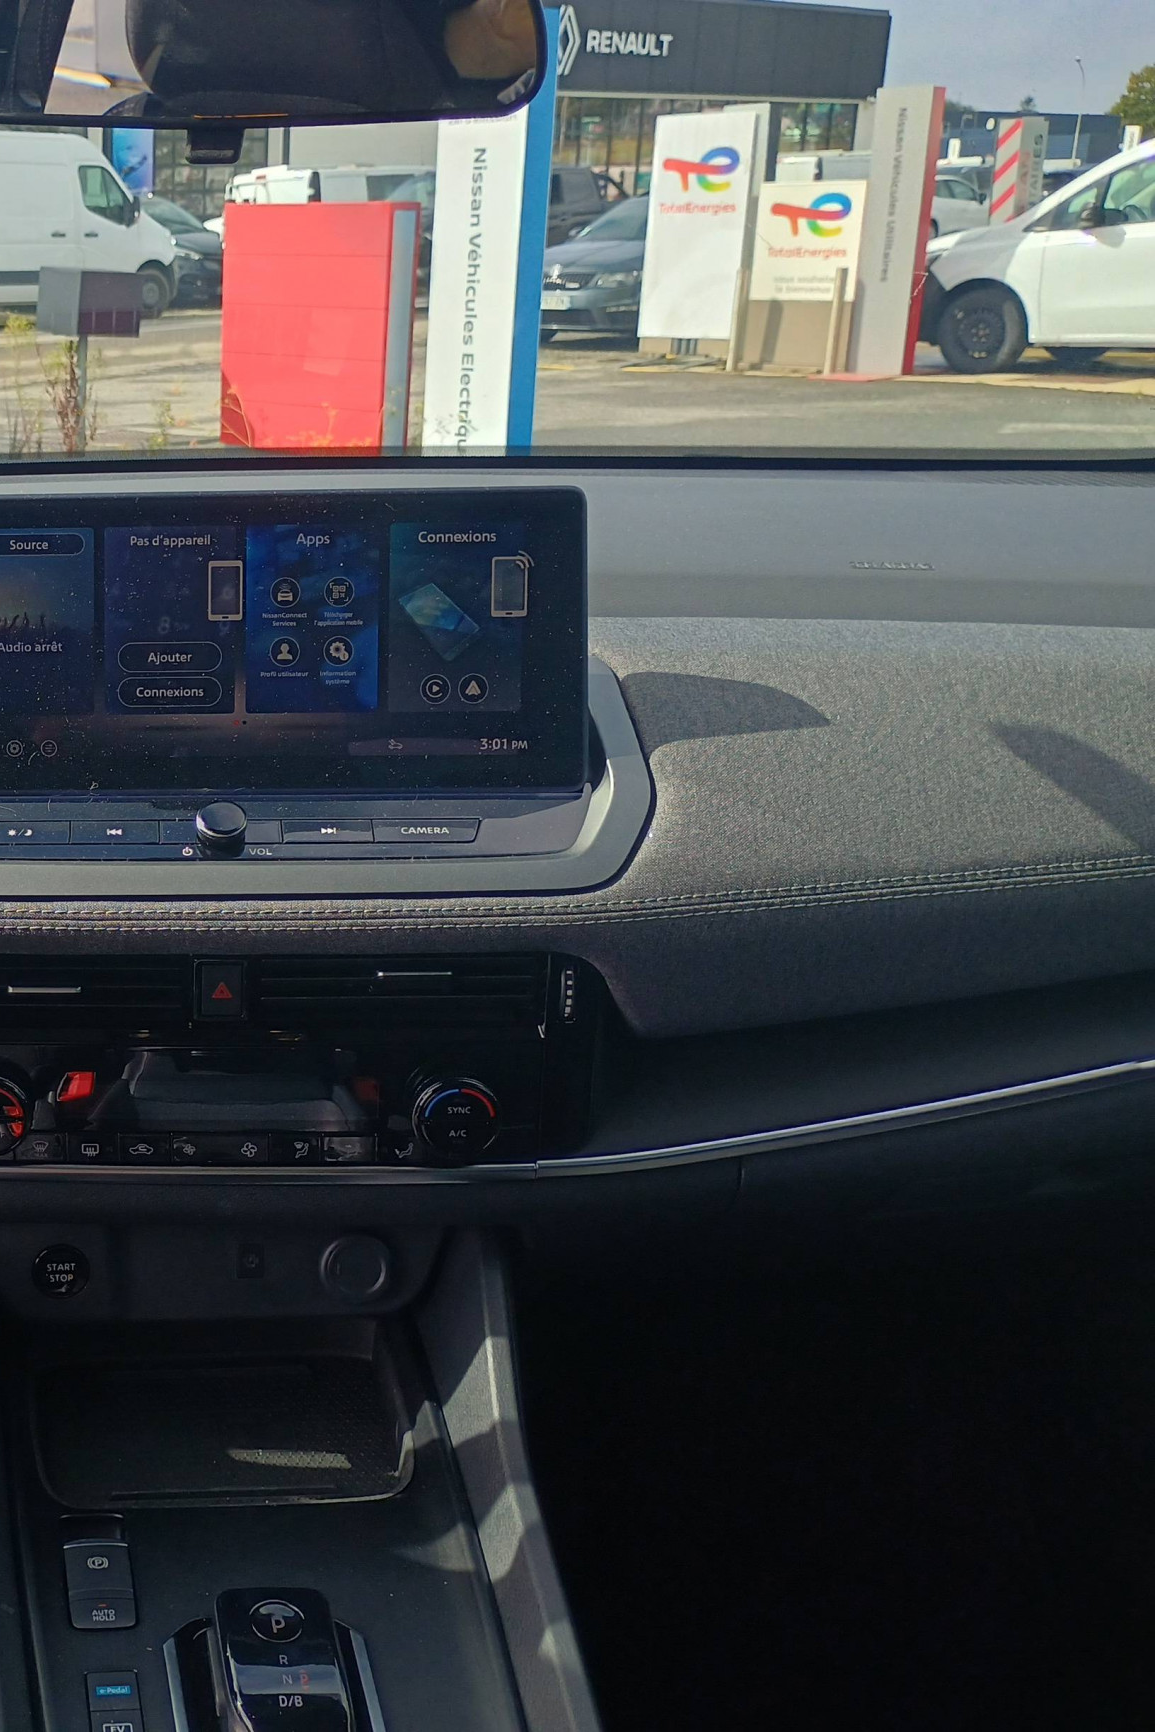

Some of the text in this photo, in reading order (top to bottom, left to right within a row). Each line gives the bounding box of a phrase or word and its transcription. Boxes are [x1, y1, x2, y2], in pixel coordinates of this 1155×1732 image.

[586, 29, 674, 57] RENAULT
[470, 148, 488, 227] Nissan
[659, 203, 736, 216] TotalEnergies
[768, 247, 847, 260] TotalEnergies
[462, 233, 483, 346] Véhicules
[130, 535, 211, 547] Pas d'appareil
[296, 533, 331, 547] Apps
[418, 531, 496, 543] Connexions
[9, 540, 49, 551] Source
[34, 641, 63, 652] arrêt
[148, 652, 192, 665] Ajouter
[136, 687, 204, 697] Connexions
[480, 738, 529, 750] 3:01 PM
[400, 825, 450, 835] CAMERA
[447, 1106, 471, 1114] SYNC
[46, 1263, 76, 1271] START
[49, 1274, 74, 1283] STOP
[91, 1609, 115, 1617] AUTO
[92, 1614, 116, 1622] HOLD
[270, 1616, 286, 1634] P
[279, 1655, 289, 1665] R
[282, 1674, 293, 1685] N
[99, 1687, 128, 1695] e-Pedal
[279, 1695, 303, 1708] D/B
